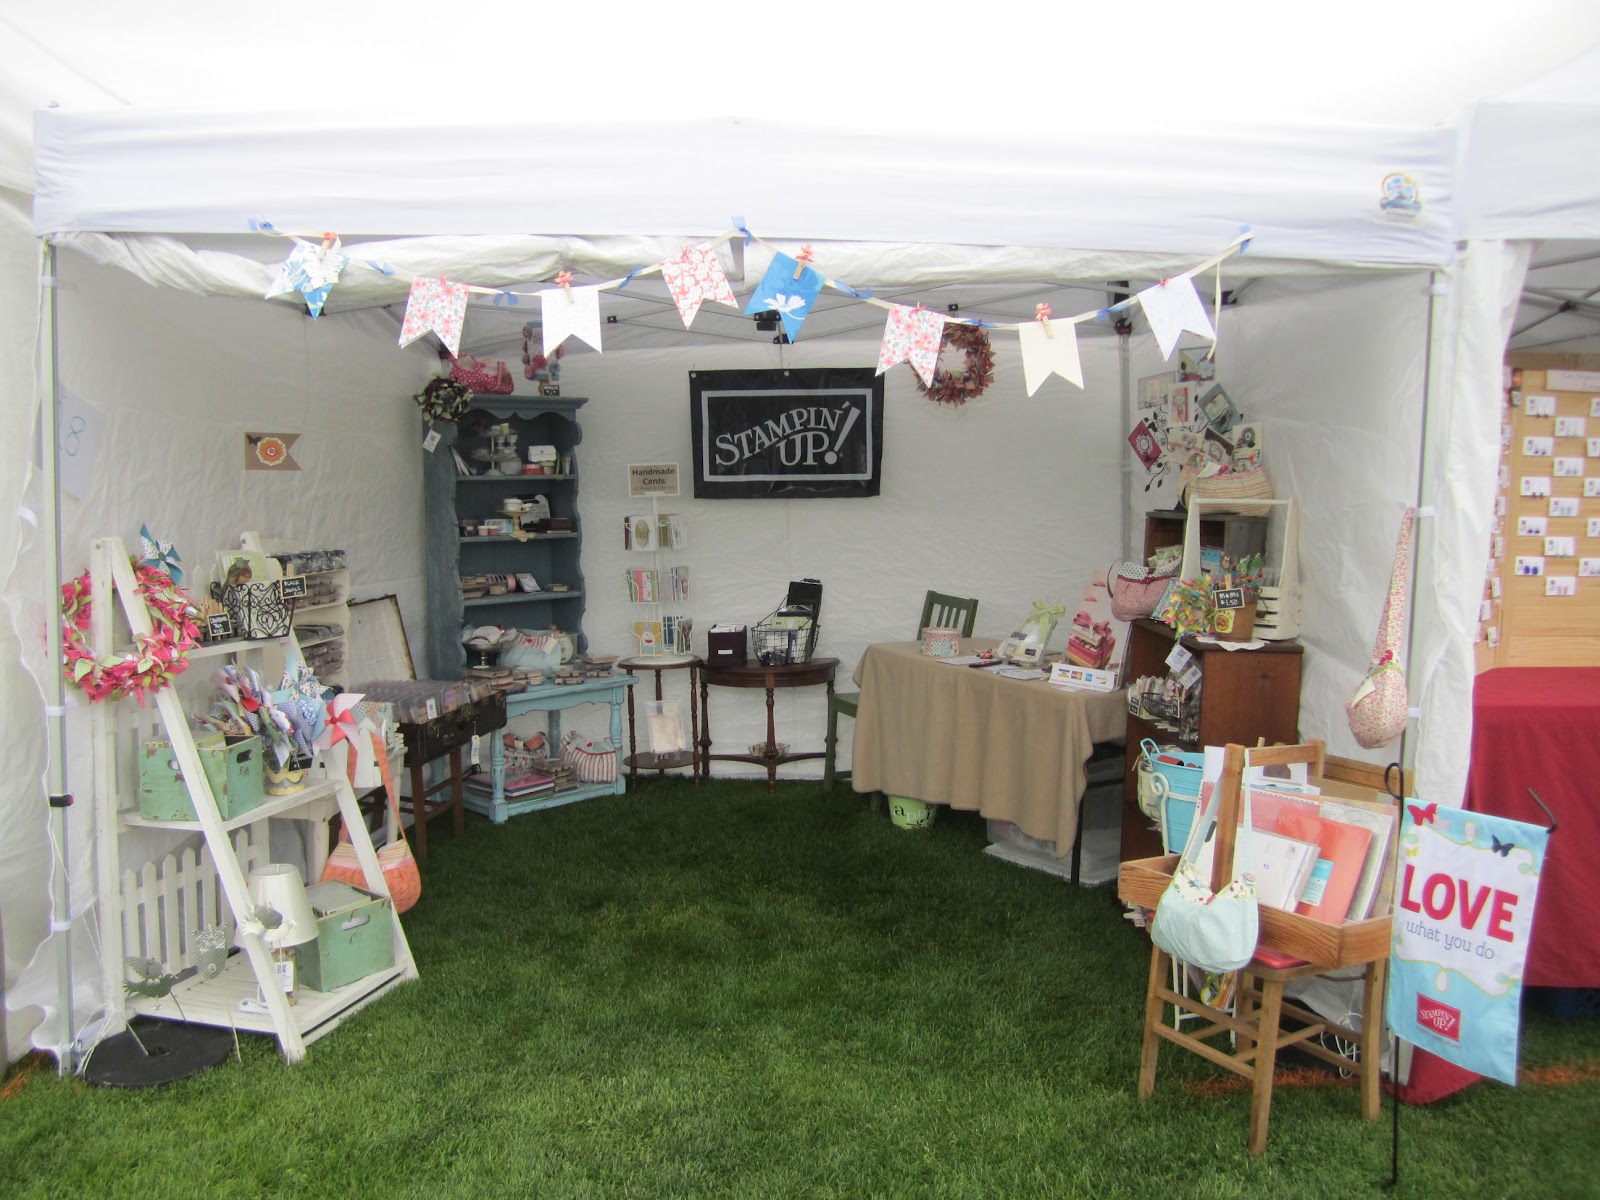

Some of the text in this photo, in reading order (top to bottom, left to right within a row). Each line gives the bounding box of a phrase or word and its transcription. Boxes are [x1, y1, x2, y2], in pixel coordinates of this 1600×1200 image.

[715, 401, 850, 466] STAMPIN'
[775, 406, 861, 466] UP!
[632, 468, 675, 476] Handmade
[1400, 864, 1518, 942] LOVE
[1406, 921, 1494, 960] what you do
[1433, 1017, 1456, 1030] UP!
